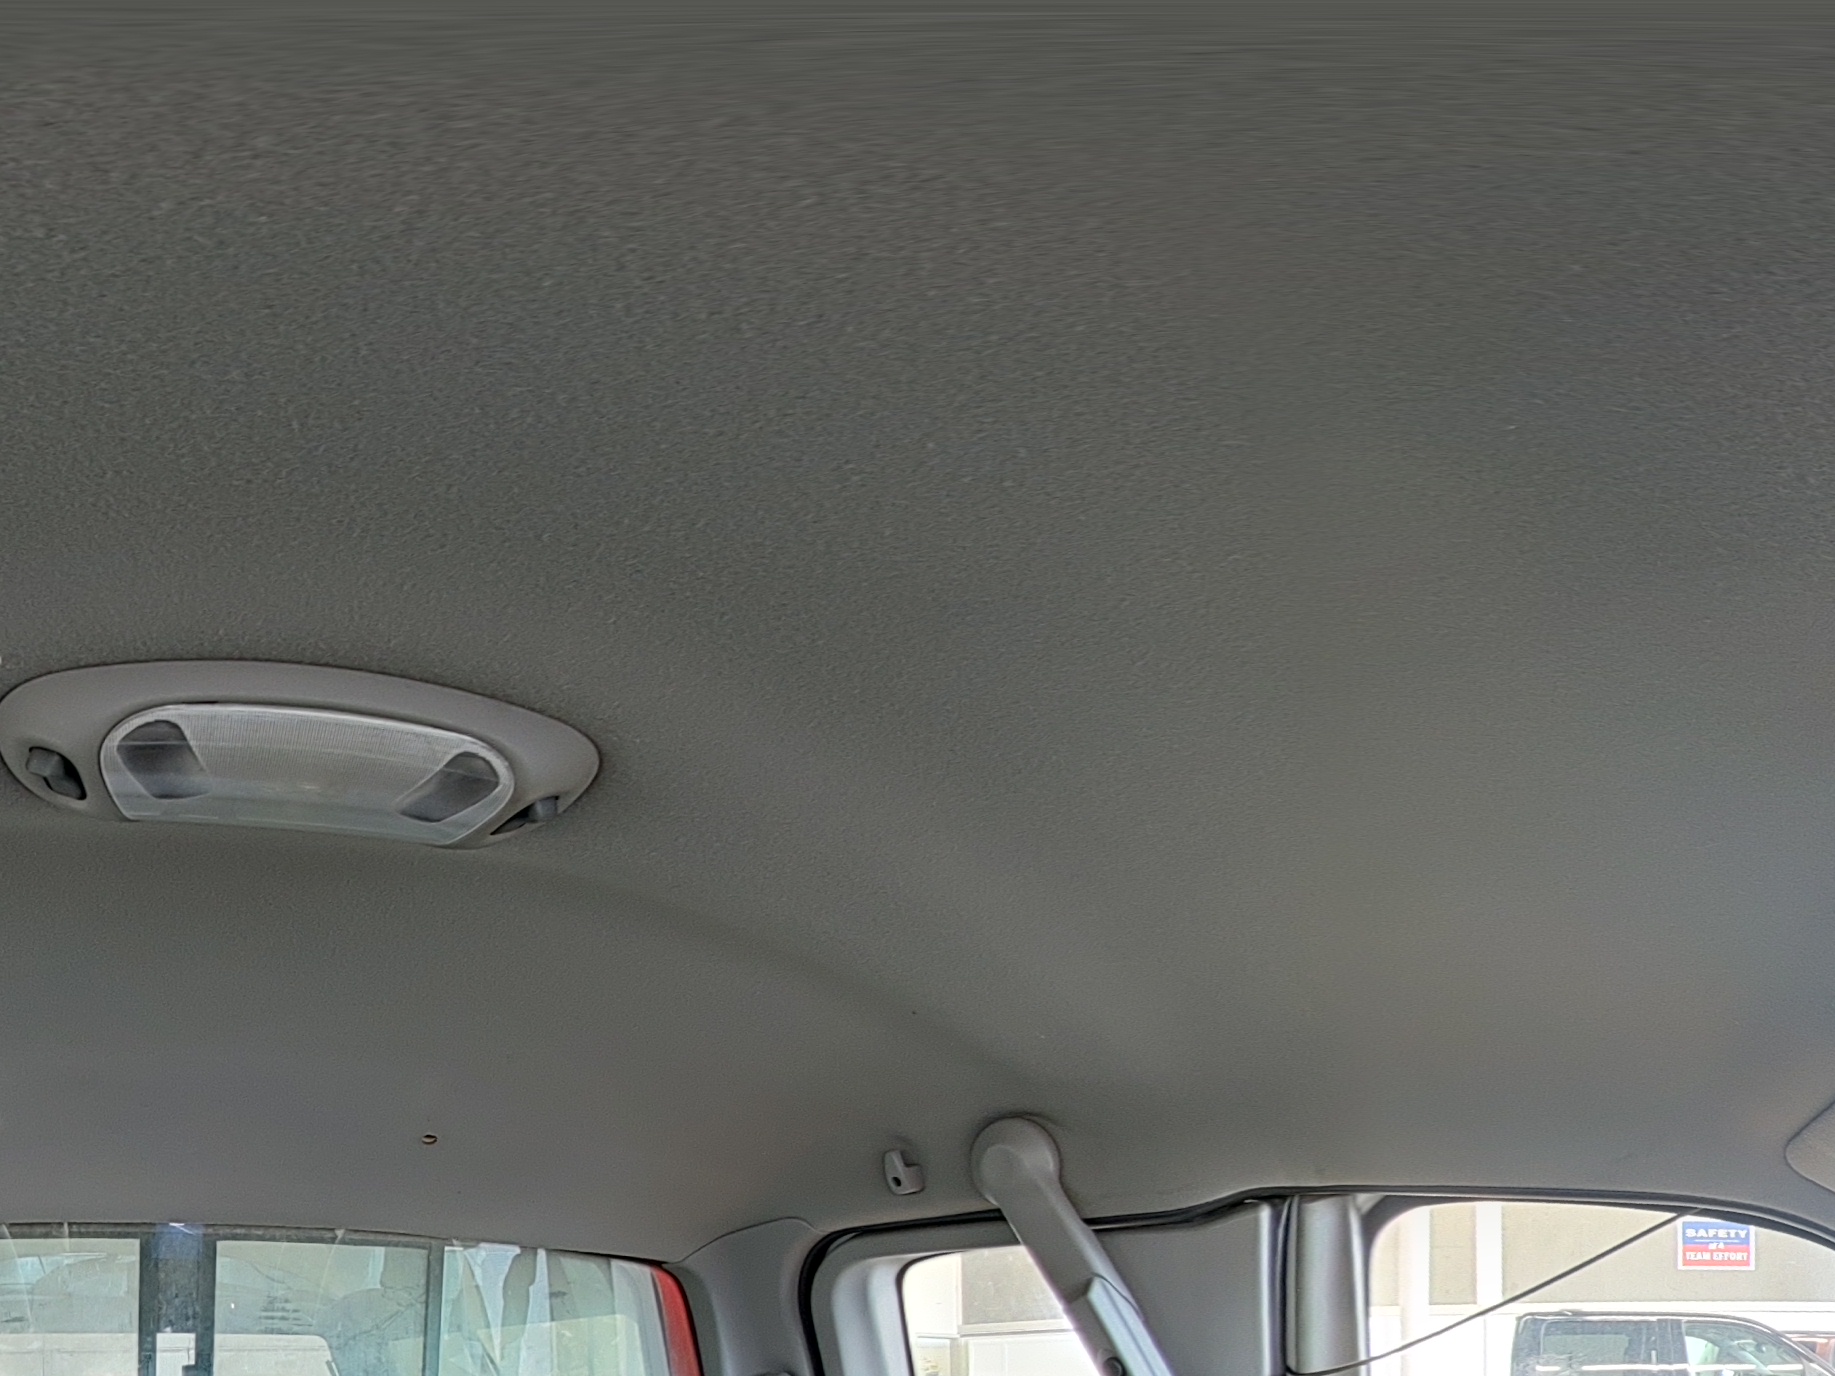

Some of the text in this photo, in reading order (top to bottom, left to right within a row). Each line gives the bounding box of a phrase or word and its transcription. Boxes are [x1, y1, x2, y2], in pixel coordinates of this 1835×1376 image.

[1686, 1228, 1748, 1239] SAFETY
[1686, 1251, 1748, 1261] TEAM EFFORT
